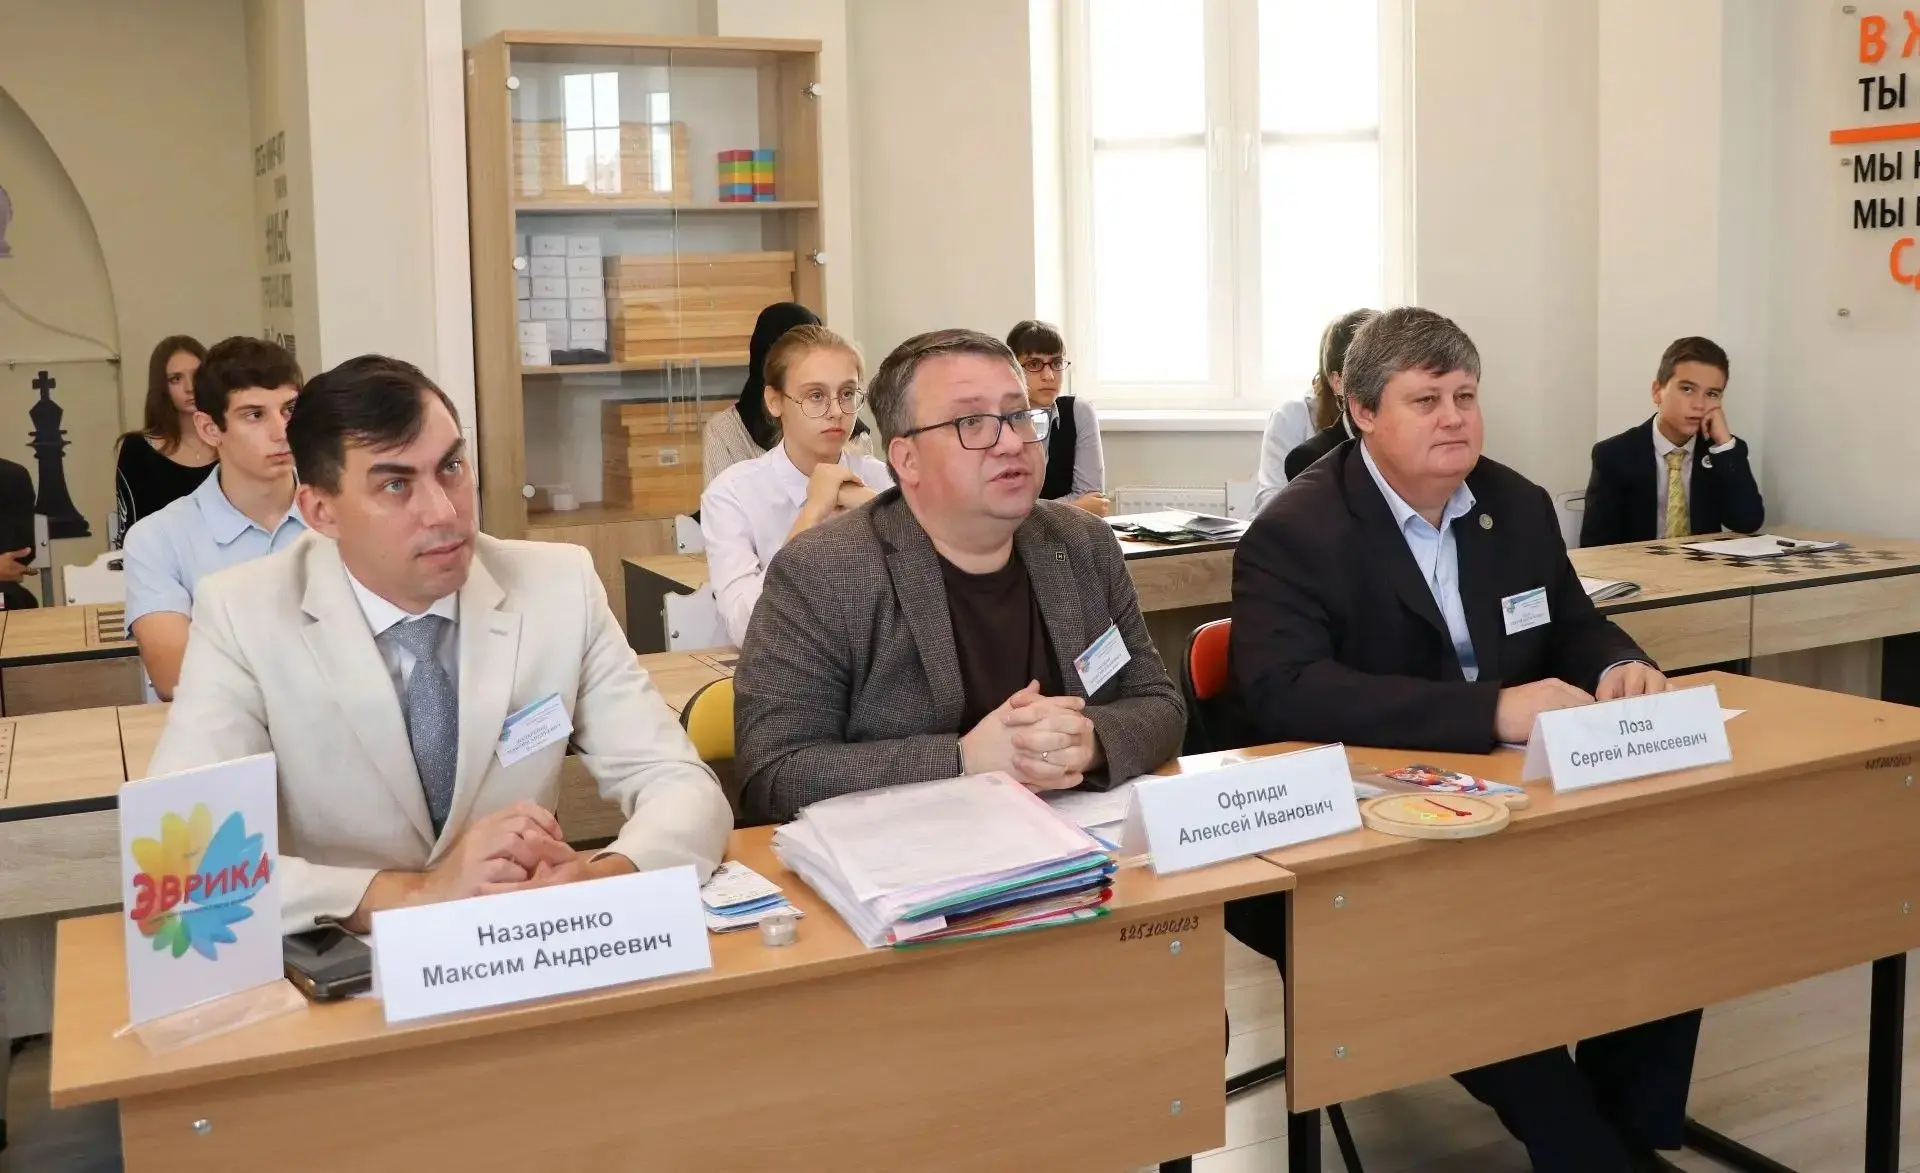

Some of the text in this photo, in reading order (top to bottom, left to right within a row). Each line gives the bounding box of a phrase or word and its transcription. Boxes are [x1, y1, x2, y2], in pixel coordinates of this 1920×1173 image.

[1859, 15, 1886, 63] В
[1859, 73, 1906, 112] ТЫ
[1854, 152, 1902, 183] МЫ
[1854, 197, 1904, 229] МЫ
[1619, 718, 1653, 736] Лоза
[1571, 732, 1708, 768] Сергей Алексеевич
[1218, 784, 1288, 811] Офлиди
[1179, 799, 1334, 845] Алексей Иванович
[130, 851, 270, 921] ЭВРИКА
[477, 911, 613, 946] Назаренко
[422, 932, 673, 988] Максим Андреевич
